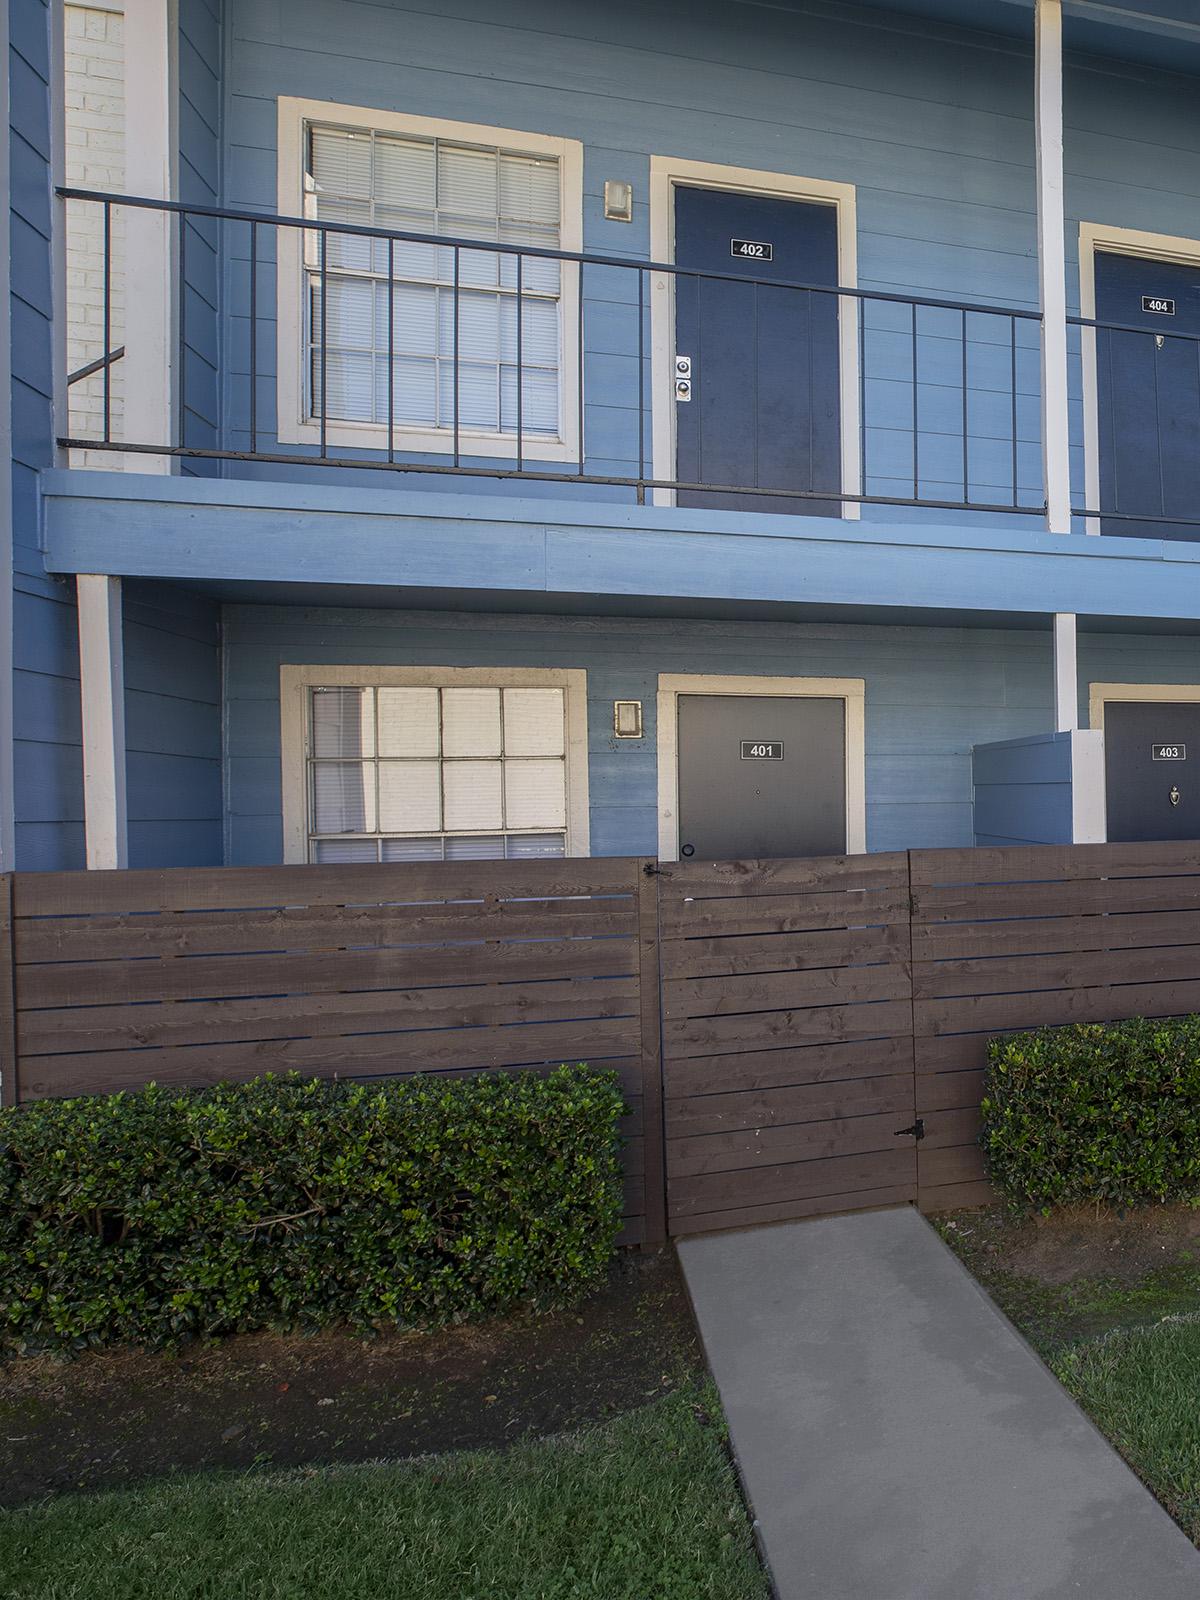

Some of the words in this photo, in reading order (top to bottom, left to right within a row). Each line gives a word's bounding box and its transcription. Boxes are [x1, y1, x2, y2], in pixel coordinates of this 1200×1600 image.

[740, 244, 763, 256] 402
[1149, 300, 1168, 311] 404
[750, 745, 773, 757] 401
[1159, 747, 1178, 758] 403
